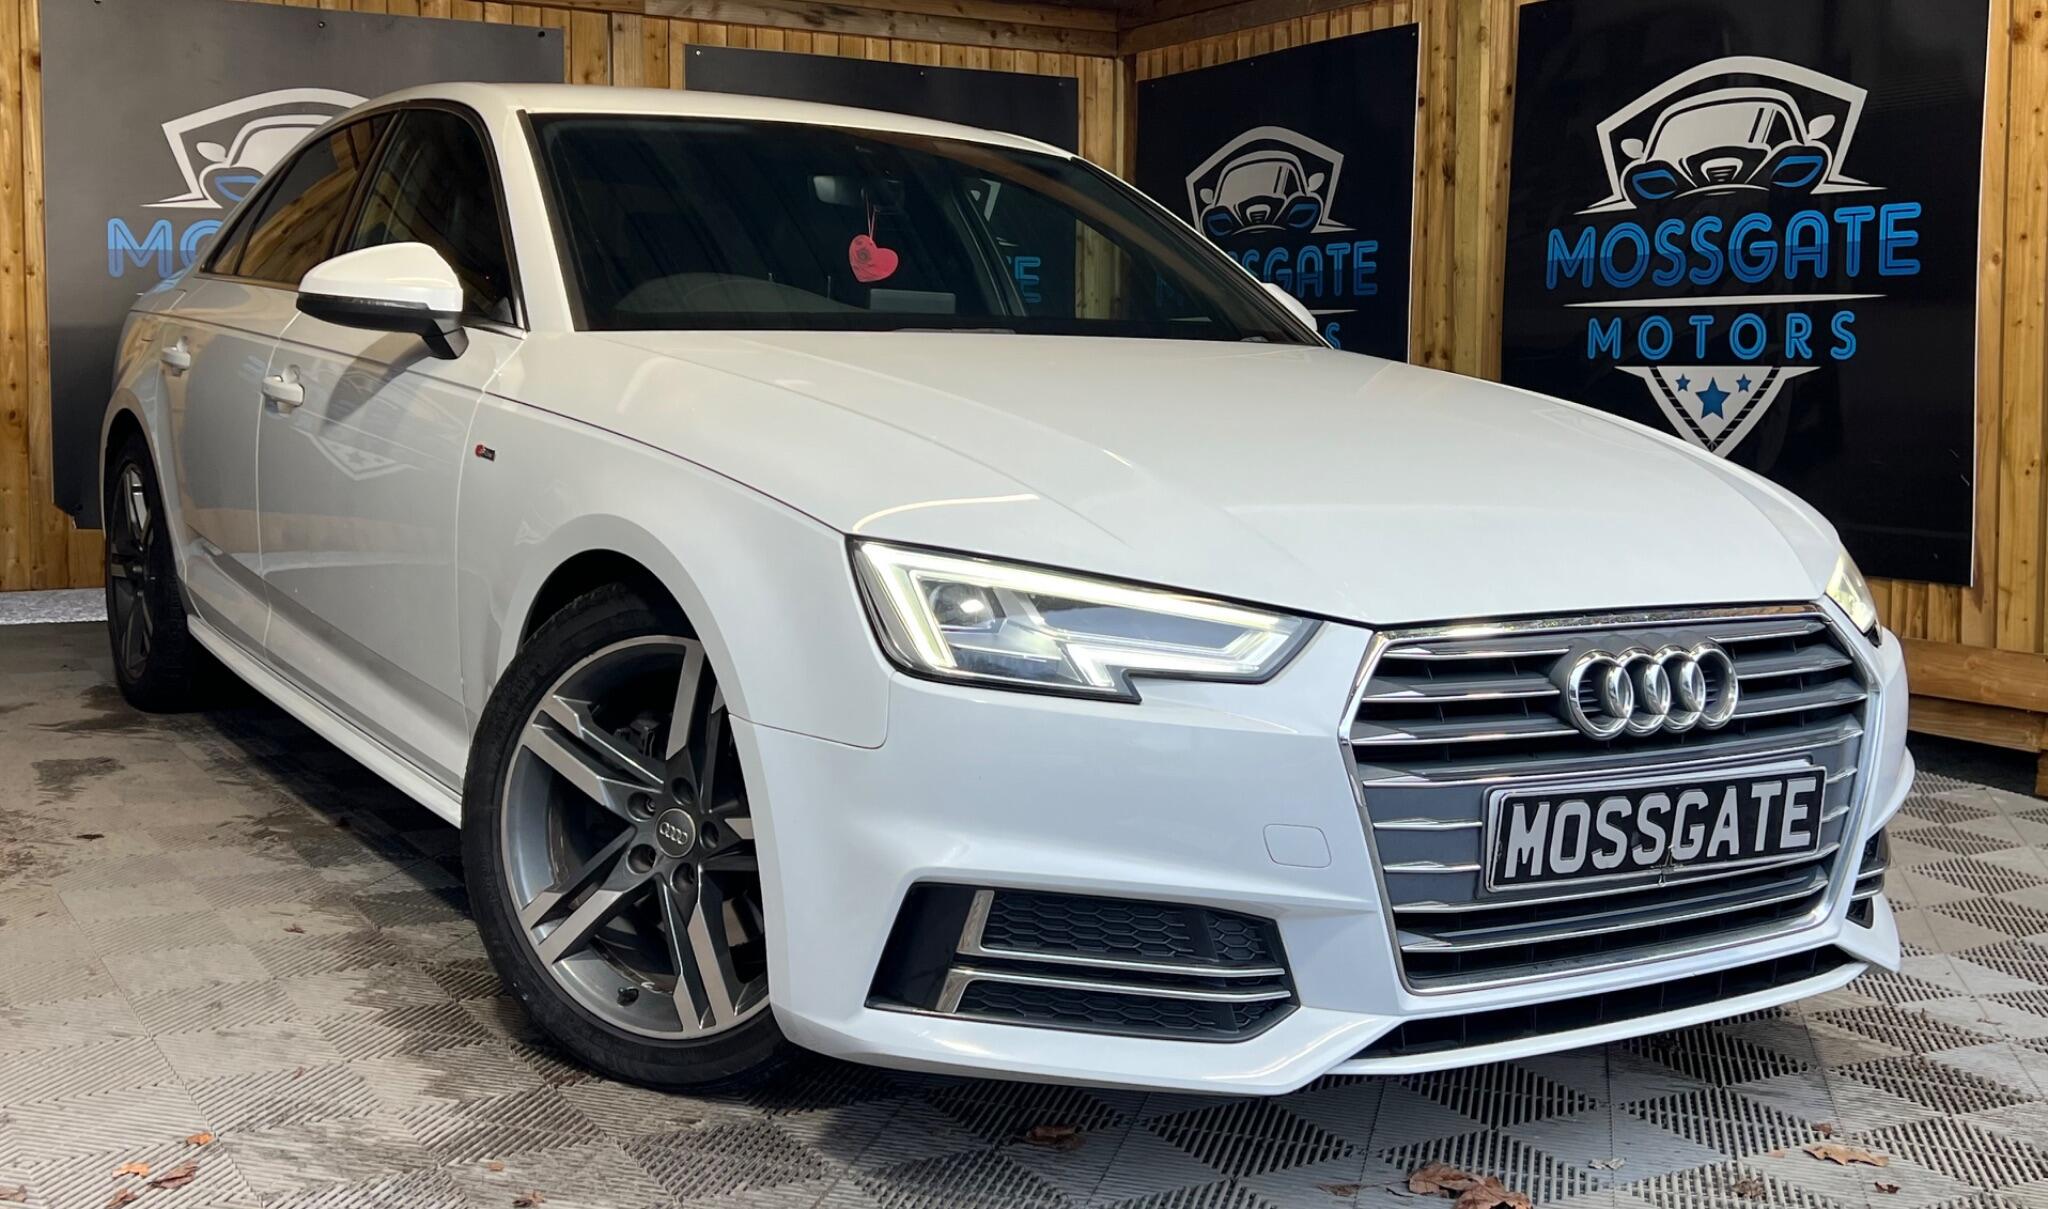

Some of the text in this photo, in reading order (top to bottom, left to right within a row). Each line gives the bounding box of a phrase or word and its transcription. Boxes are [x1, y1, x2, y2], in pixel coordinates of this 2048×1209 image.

[1546, 202, 1921, 290] MOSSGATE
[1587, 310, 1857, 361] MOTORS
[1504, 776, 1816, 879] MOSSGATE
